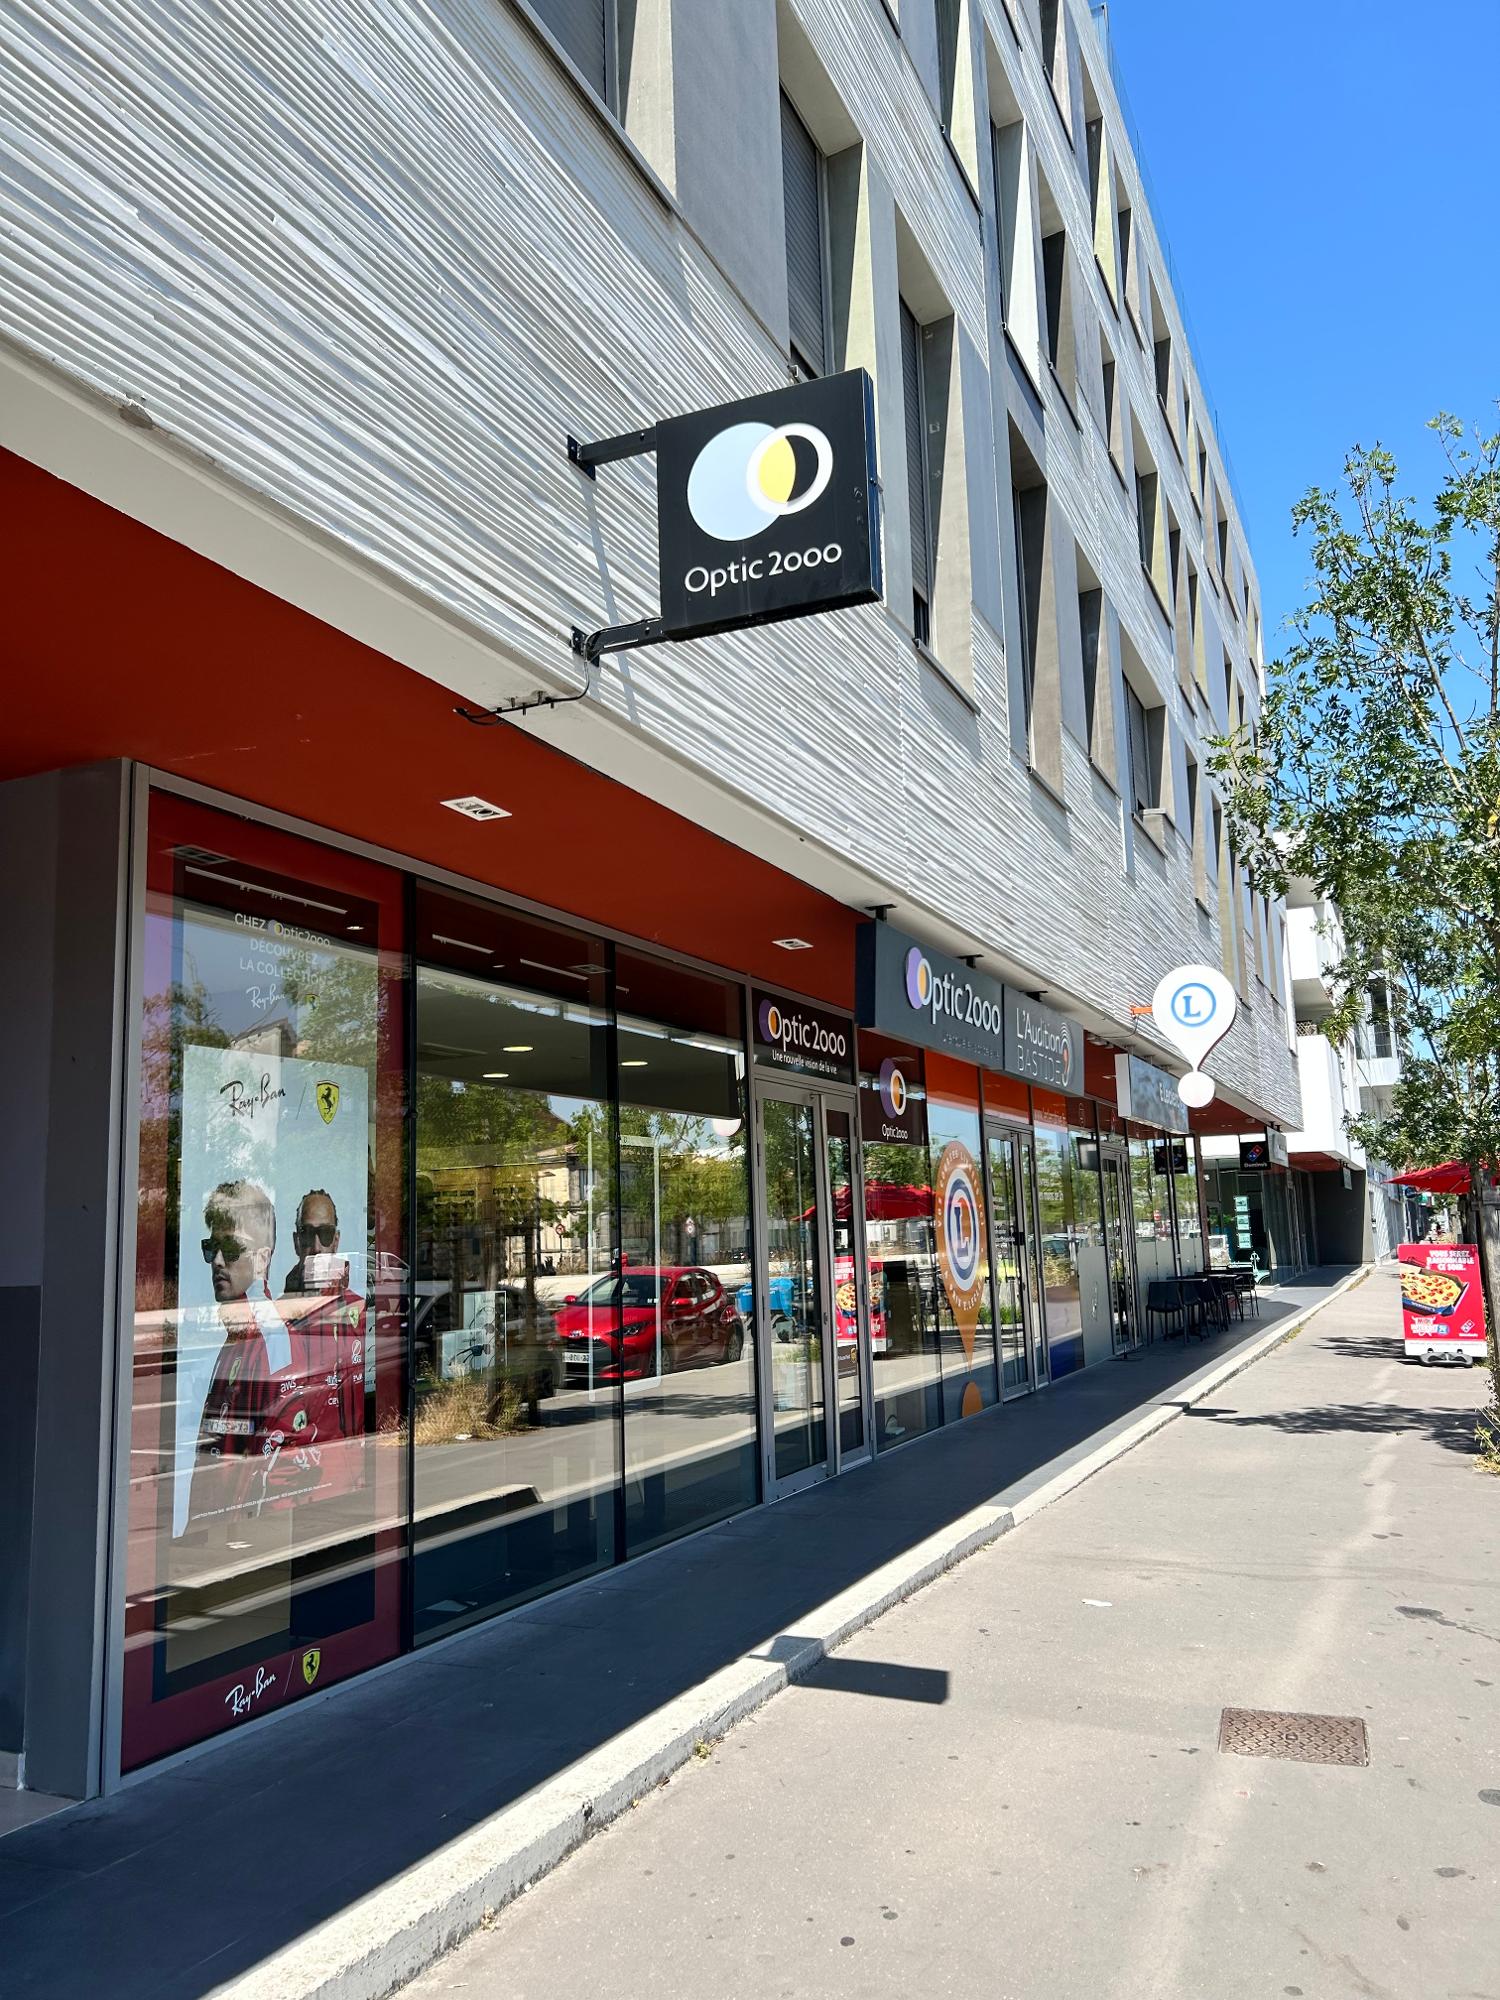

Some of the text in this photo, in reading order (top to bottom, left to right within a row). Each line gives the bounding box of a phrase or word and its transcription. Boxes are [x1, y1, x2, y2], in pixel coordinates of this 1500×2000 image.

[684, 542, 842, 597] Optic 2000
[234, 912, 268, 932] CHEZ
[274, 922, 304, 943] Optic
[240, 958, 255, 972] LA
[250, 937, 319, 965] DÉCOUVREZ
[246, 983, 286, 1010] Ray-Ban
[916, 958, 1001, 1035] Optic 2000
[1182, 995, 1201, 1018] L
[768, 1006, 846, 1057] Optic 2000
[1016, 1007, 1061, 1052] L'Audition
[772, 1049, 783, 1062] Une
[1017, 1044, 1062, 1085] BASTIDE
[219, 1072, 286, 1119] Ray-Ban
[224, 1666, 277, 1717] Ray-Ban
